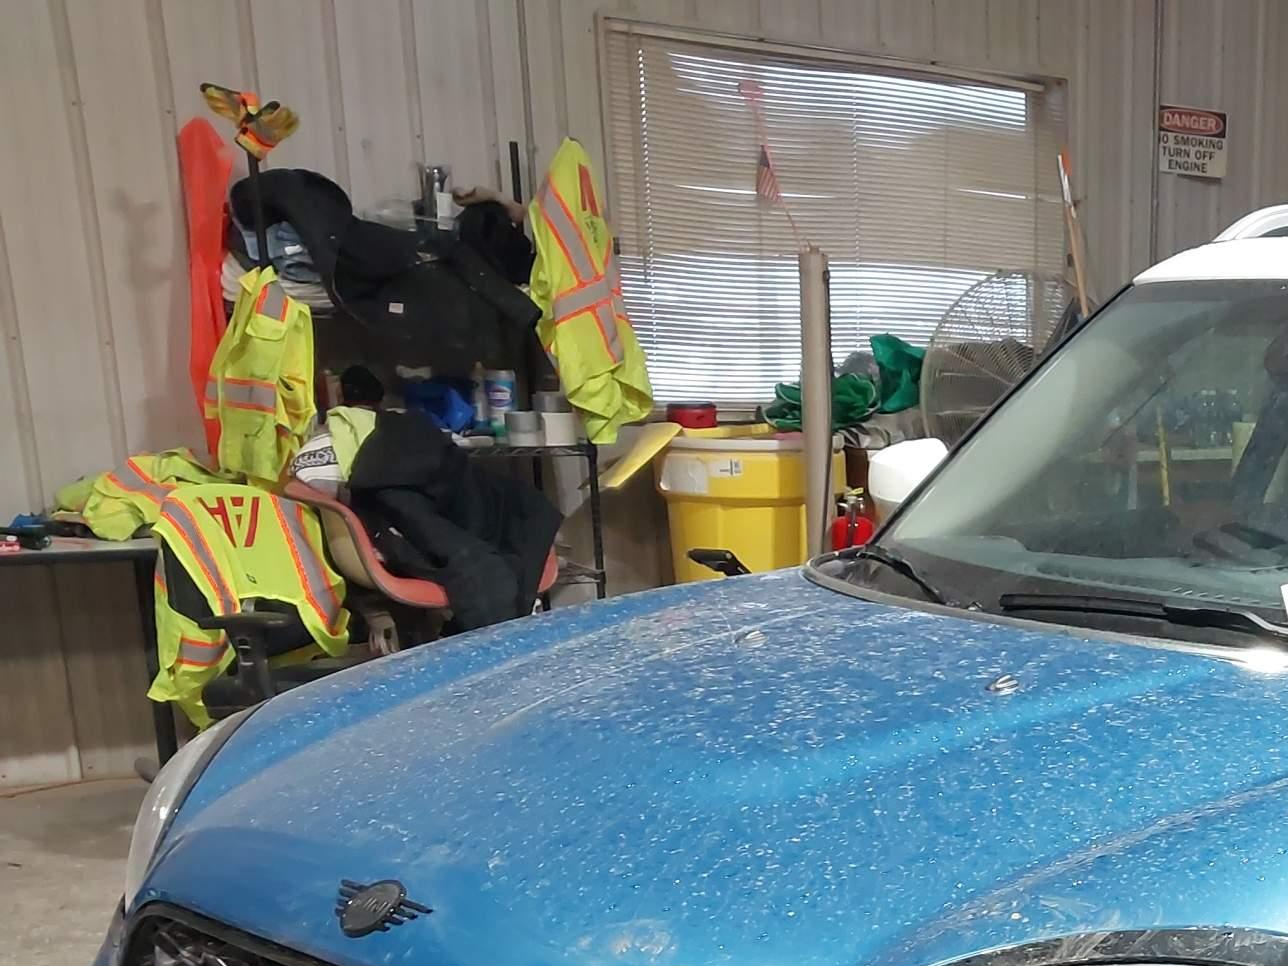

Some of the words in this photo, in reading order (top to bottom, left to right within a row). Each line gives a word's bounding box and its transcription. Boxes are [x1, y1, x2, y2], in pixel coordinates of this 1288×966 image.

[1163, 112, 1217, 132] DANGER
[1173, 135, 1224, 151] SMOKING
[1162, 146, 1190, 159] TURN
[1194, 149, 1216, 161] OFF
[1167, 158, 1208, 174] ENGINE
